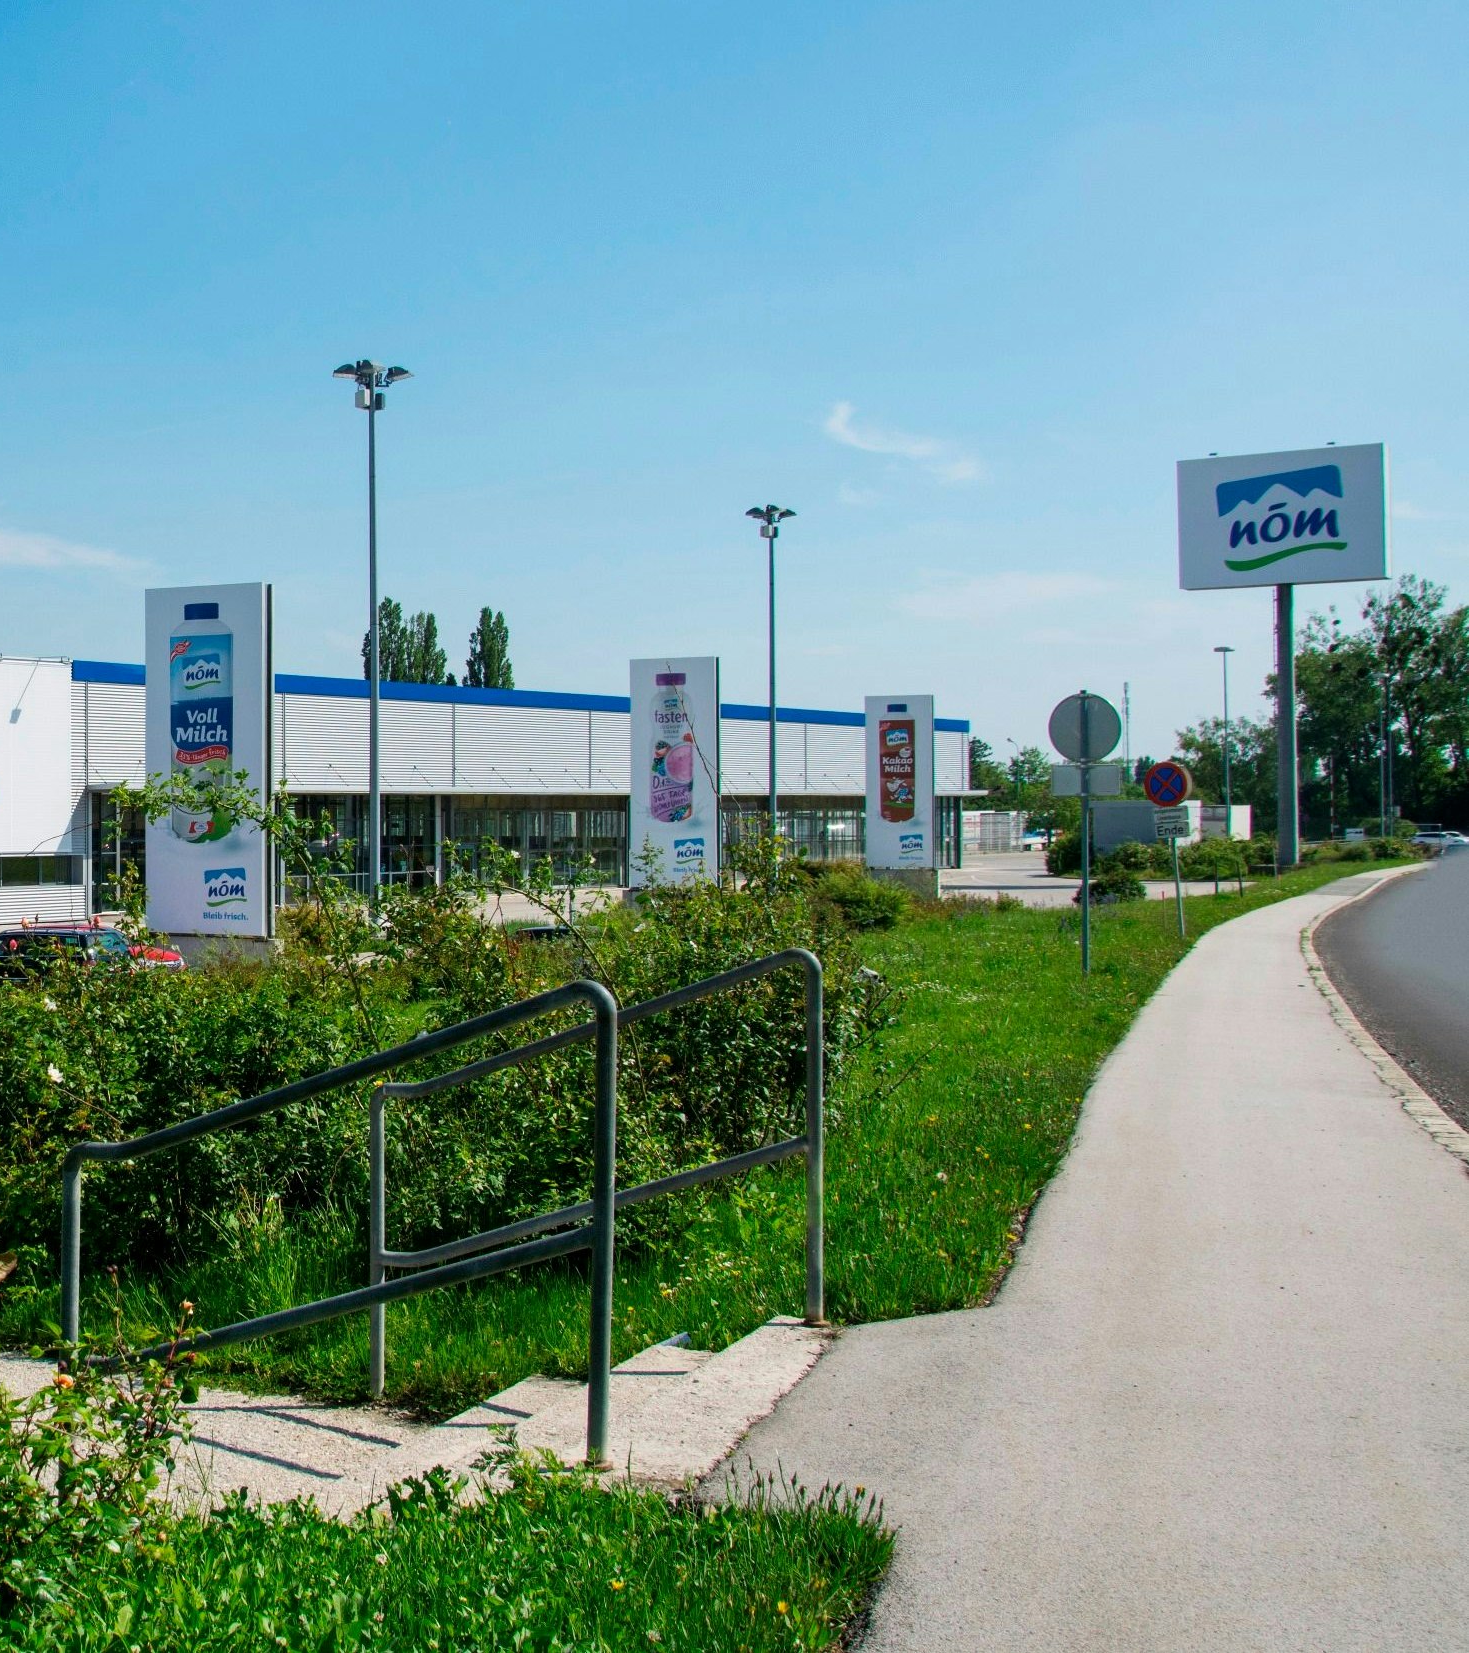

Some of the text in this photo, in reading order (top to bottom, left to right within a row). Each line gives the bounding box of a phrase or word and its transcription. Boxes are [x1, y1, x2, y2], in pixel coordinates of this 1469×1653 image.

[186, 707, 218, 724] Voll
[655, 710, 688, 723] fasten
[176, 724, 228, 743] Milch
[882, 756, 913, 765] Kakao
[884, 764, 912, 773] Milch
[1157, 824, 1184, 837] Ende
[203, 911, 249, 921] Bleib frisch.
